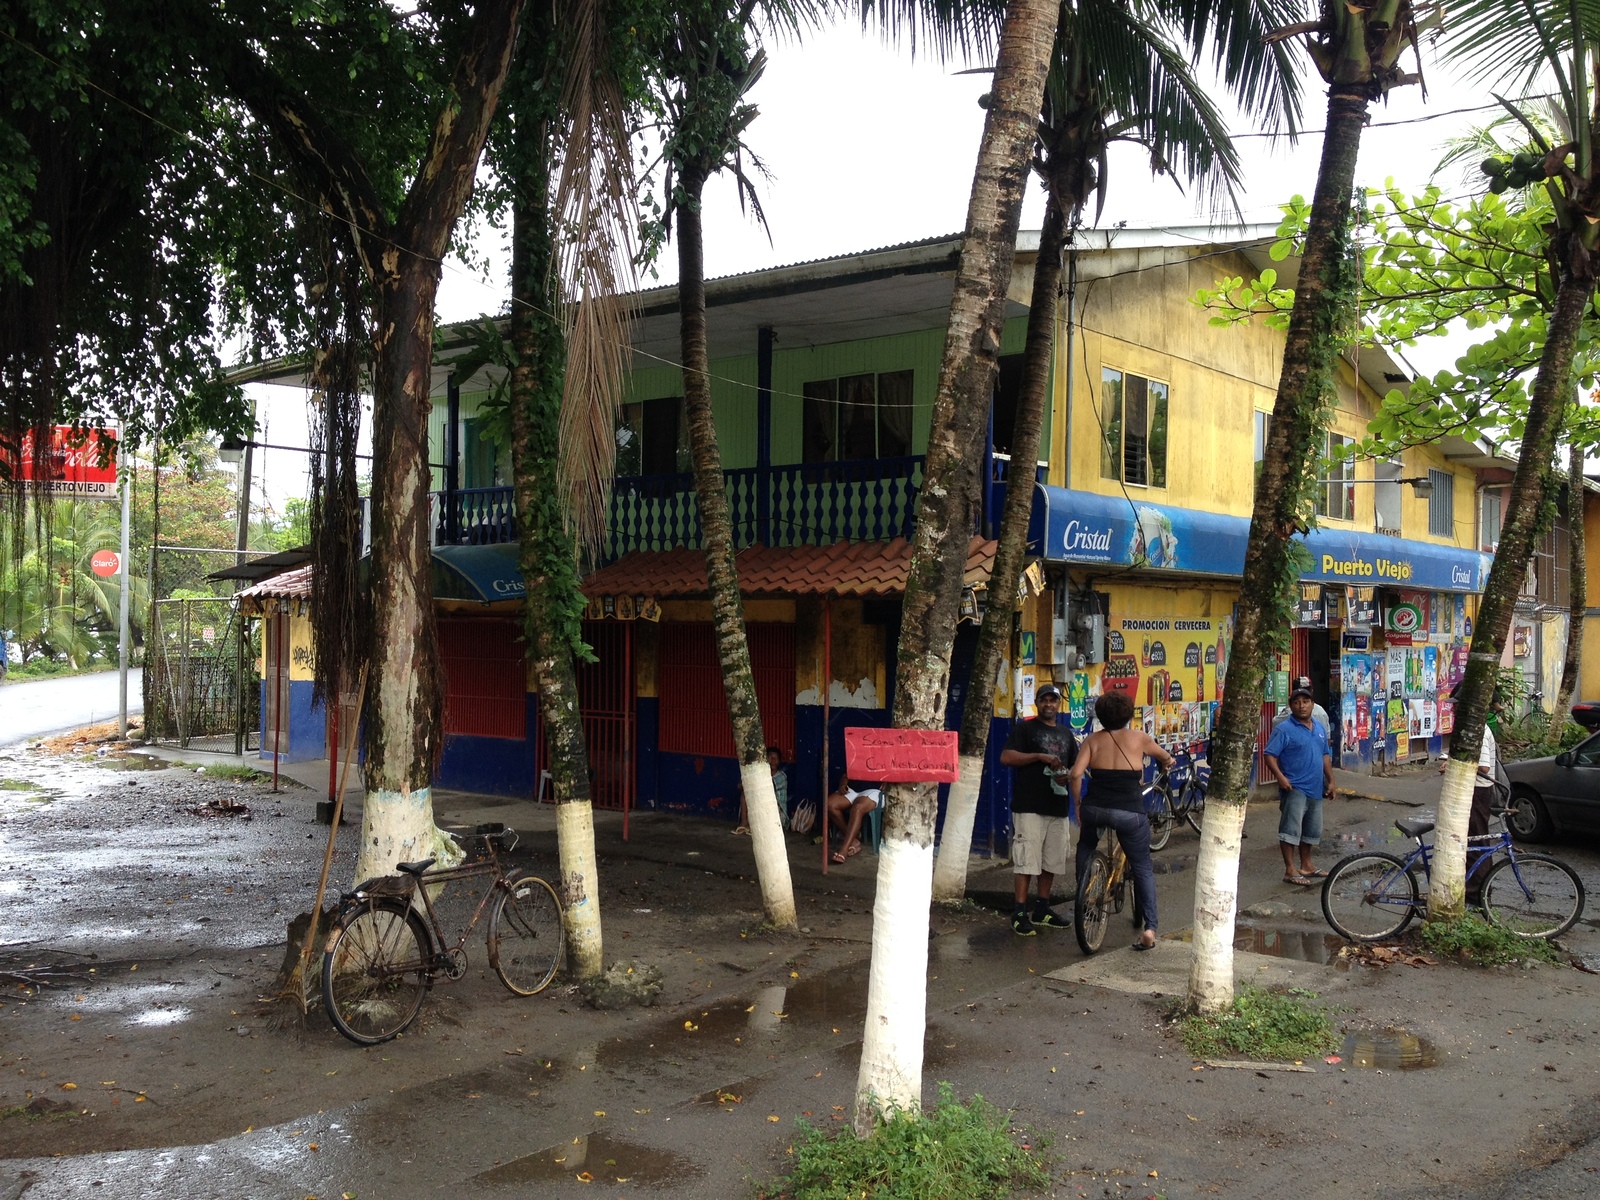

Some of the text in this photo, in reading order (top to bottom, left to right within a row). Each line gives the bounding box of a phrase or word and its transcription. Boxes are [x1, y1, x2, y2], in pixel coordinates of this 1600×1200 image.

[77, 483, 106, 492] VIEJO
[1063, 520, 1113, 551] Cristal
[1322, 554, 1373, 576] Puerto
[1376, 559, 1409, 580] Viejo
[1452, 565, 1471, 583] Cristal
[1174, 621, 1211, 631] CERVECERA
